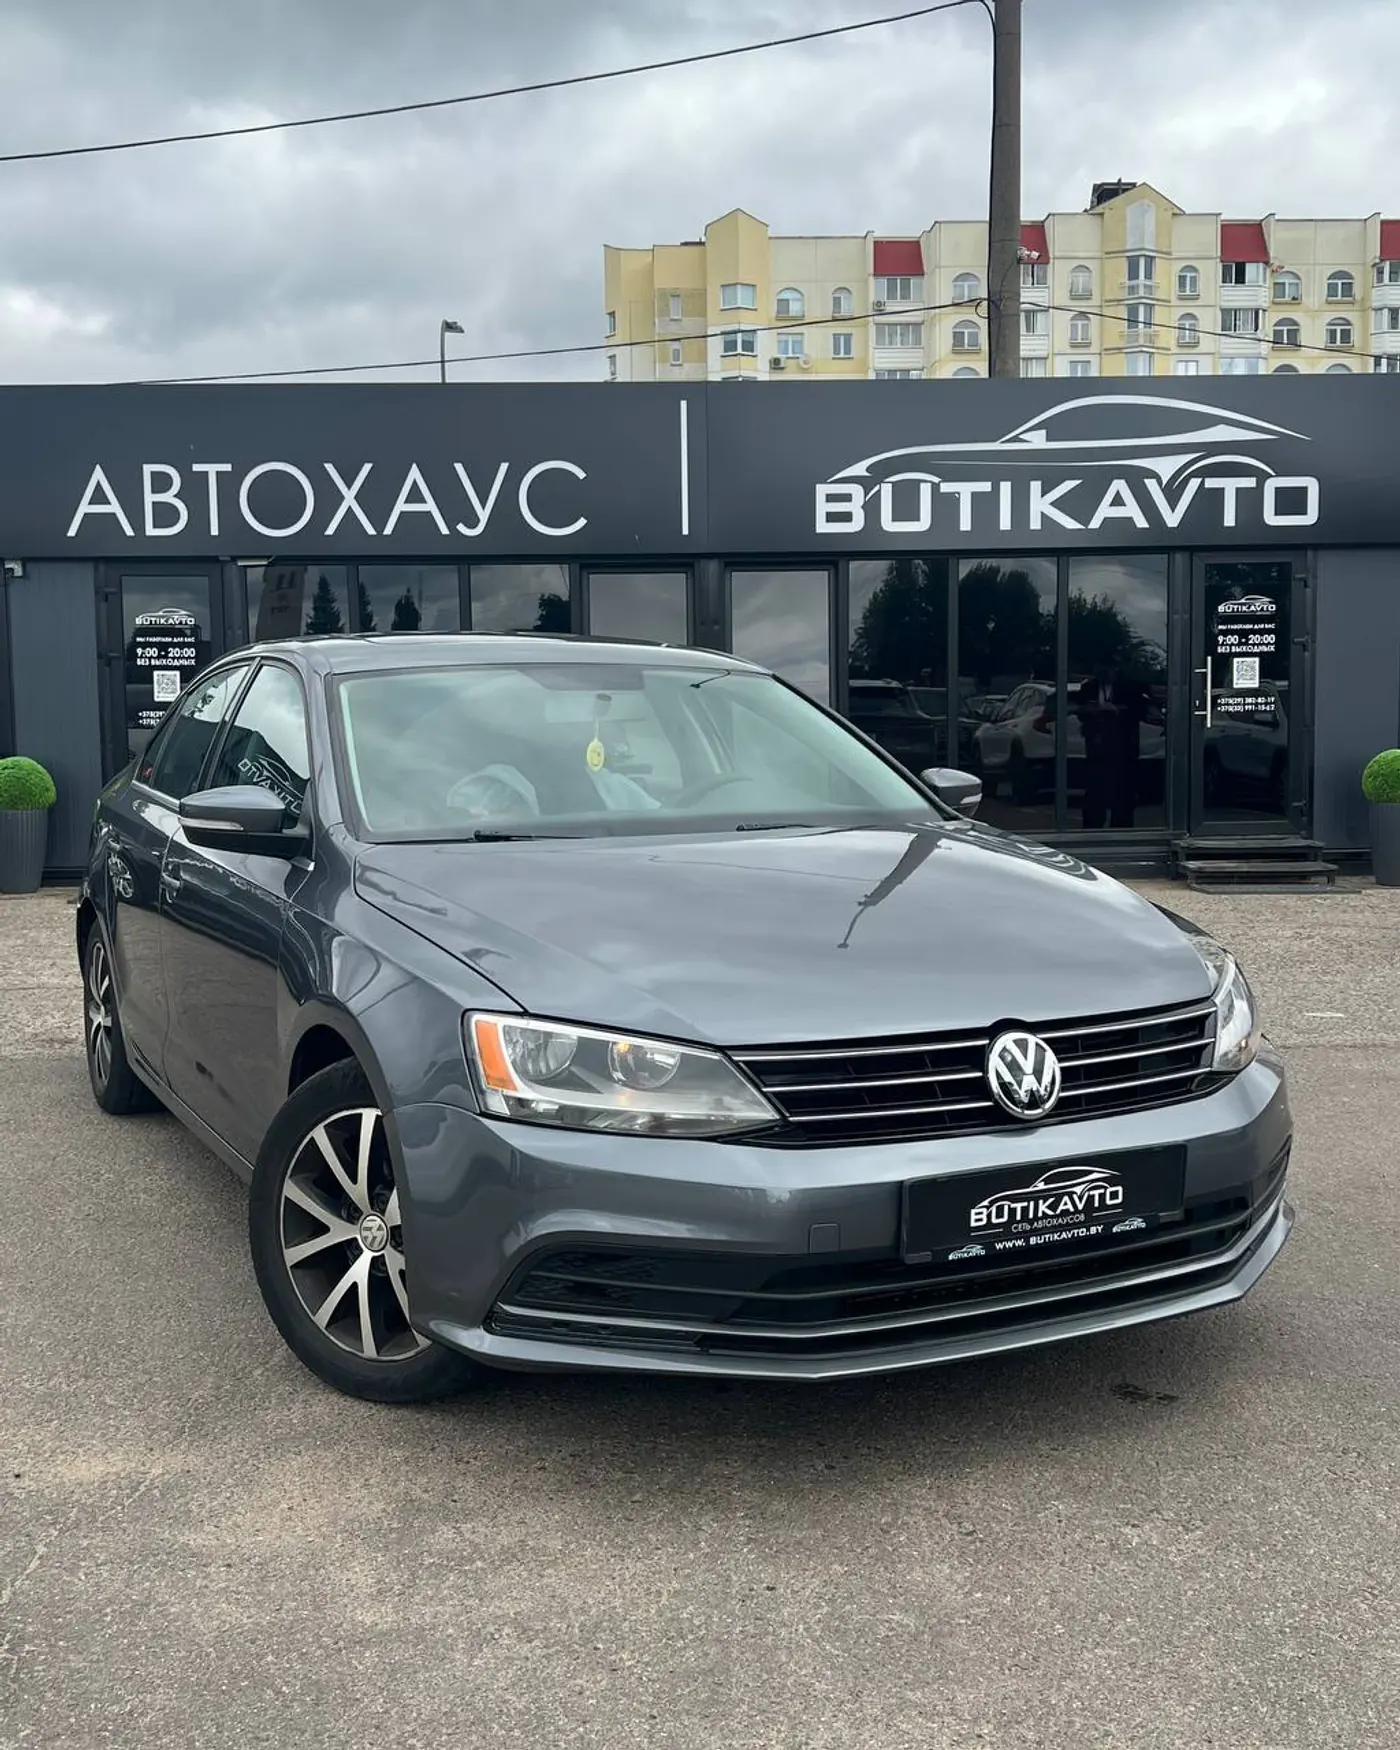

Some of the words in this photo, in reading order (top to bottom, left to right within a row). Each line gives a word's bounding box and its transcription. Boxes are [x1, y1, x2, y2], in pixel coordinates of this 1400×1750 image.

[66, 460, 589, 538] АВТОХАУС
[814, 475, 1320, 534] BUTIKAVTO
[1217, 604, 1276, 612] BUTIKAVTO
[135, 617, 195, 625] BUTIKAVTO
[1217, 635, 1239, 645] 9:00
[1248, 634, 1276, 644] 20:00
[136, 647, 159, 657] 9:00
[168, 647, 196, 657] 20:00
[1231, 645, 1275, 653] ВЫХОДНЫХ
[136, 658, 149, 666] БЕЗ
[151, 658, 196, 666] ВЫХОДНЫХ
[970, 1185, 1123, 1227] BUTIKAVTO
[1011, 1221, 1031, 1233] СЕТЬ
[1033, 1213, 1086, 1229] АВТОХАУСОВ
[995, 1238, 1026, 1250] WWW.
[1029, 1224, 1104, 1245] BUTIKAVTO.BY
